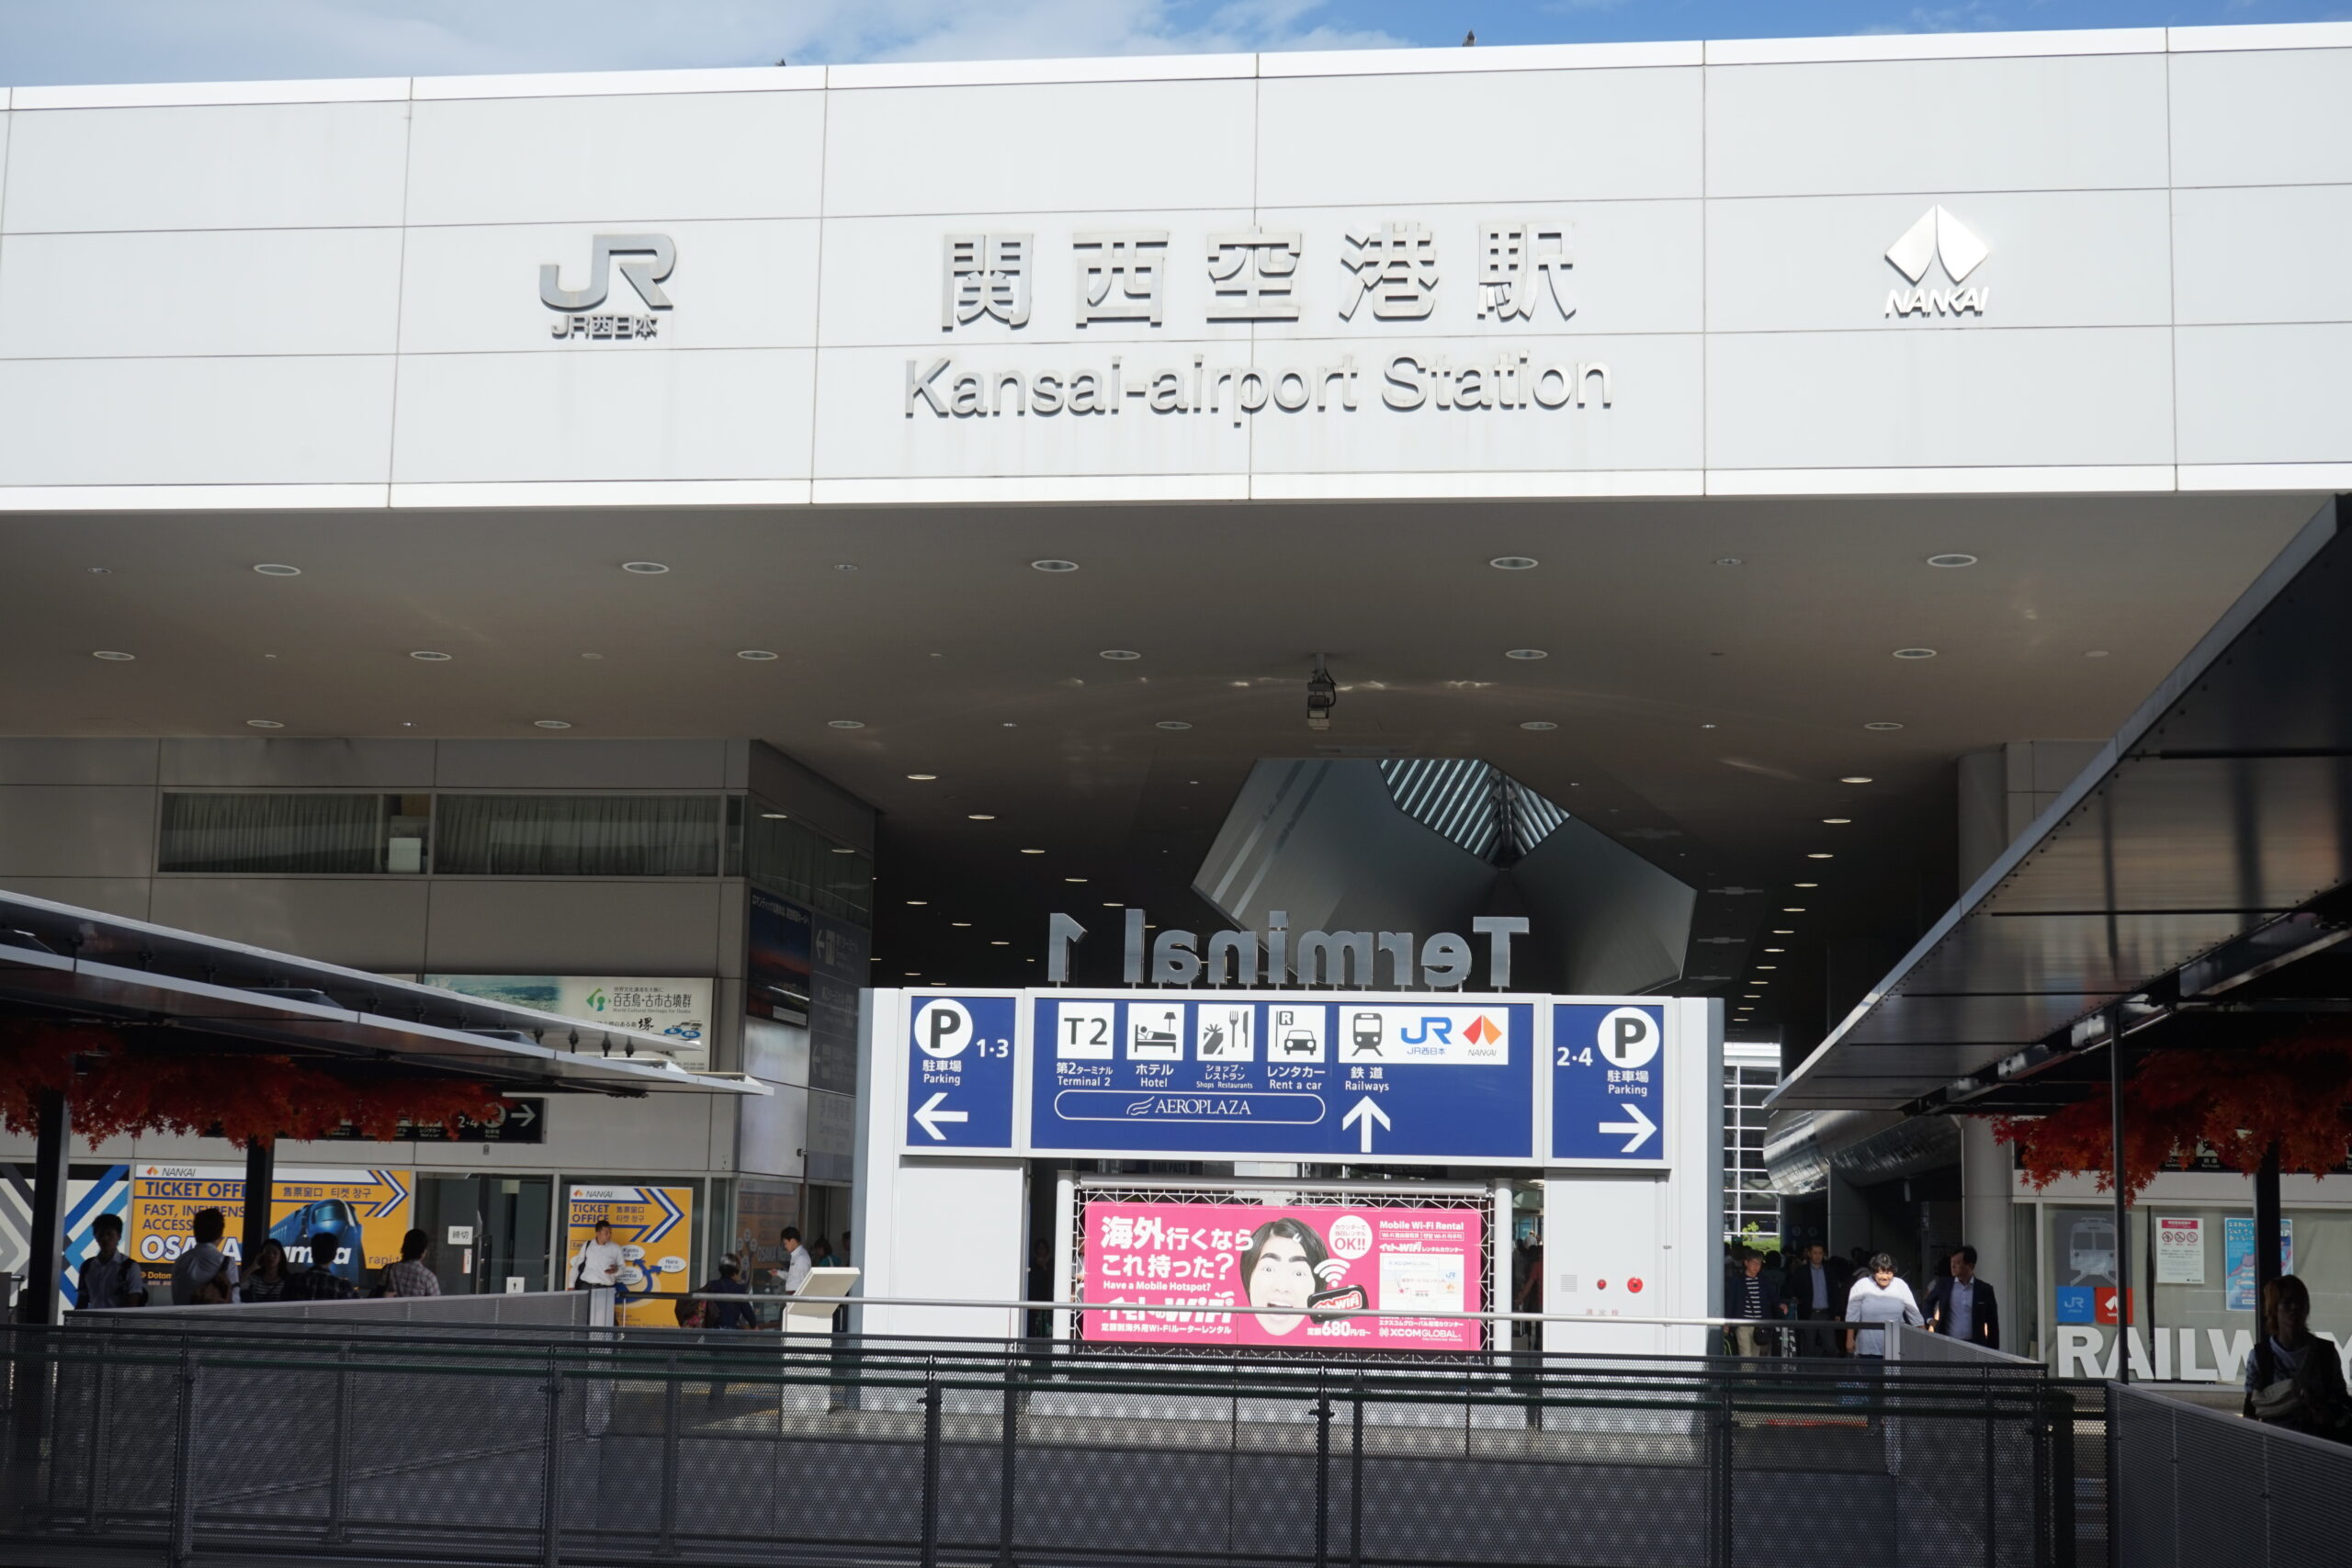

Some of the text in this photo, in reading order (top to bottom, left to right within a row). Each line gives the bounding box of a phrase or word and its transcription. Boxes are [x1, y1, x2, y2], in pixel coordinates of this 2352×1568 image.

[539, 233, 677, 312] JR
[942, 221, 1577, 331] 関西空港駅
[1885, 287, 1989, 319] NANKAI
[551, 314, 659, 340] JR西日本
[905, 349, 1612, 428] Kansai-airport Station
[930, 1009, 961, 1049] P
[1064, 1017, 1108, 1046] T2
[1401, 1017, 1453, 1045] JR
[1615, 1017, 1646, 1059] P
[1407, 1047, 1446, 1055] JR西日本
[922, 1060, 962, 1073] 駐車場
[1057, 1062, 1114, 1075] 第2ターミナル
[1136, 1064, 1174, 1076] ホテル
[1268, 1066, 1326, 1078] レンタカー
[1351, 1066, 1384, 1079] 鉄道
[923, 1074, 961, 1086] Parking
[1057, 1076, 1111, 1087] Terminal 2
[1140, 1077, 1168, 1088] Hotel
[1205, 1072, 1245, 1080] レストラン
[1607, 1070, 1648, 1083] 駐車場
[1196, 1081, 1253, 1089] Shops Restaurants
[1270, 1079, 1322, 1090] Rent a car
[1345, 1080, 1390, 1093] Railways
[1608, 1084, 1647, 1097] Parking
[1155, 1099, 1251, 1115] AEROPLAZA
[162, 1168, 196, 1177] NANKAI
[145, 1181, 246, 1197] TICKET OFFI
[331, 1188, 371, 1198] 티켓 창구
[144, 1203, 177, 1217] FAST,
[572, 1204, 609, 1213] TICKET
[572, 1213, 609, 1223] OFFICE
[142, 1219, 194, 1231] ACCESS
[1380, 1221, 1464, 1231] Mobile Wi-Fi Rental
[1101, 1216, 1253, 1250] 海外行くなら
[141, 1235, 242, 1262] OSAA
[1334, 1237, 1365, 1250] OK!!
[1102, 1253, 1234, 1280] これ持った?
[1103, 1280, 1127, 1290] Have
[1136, 1281, 1168, 1291] Mobile
[1170, 1282, 1211, 1293] Hotspot?
[2064, 1296, 2085, 1308] JR
